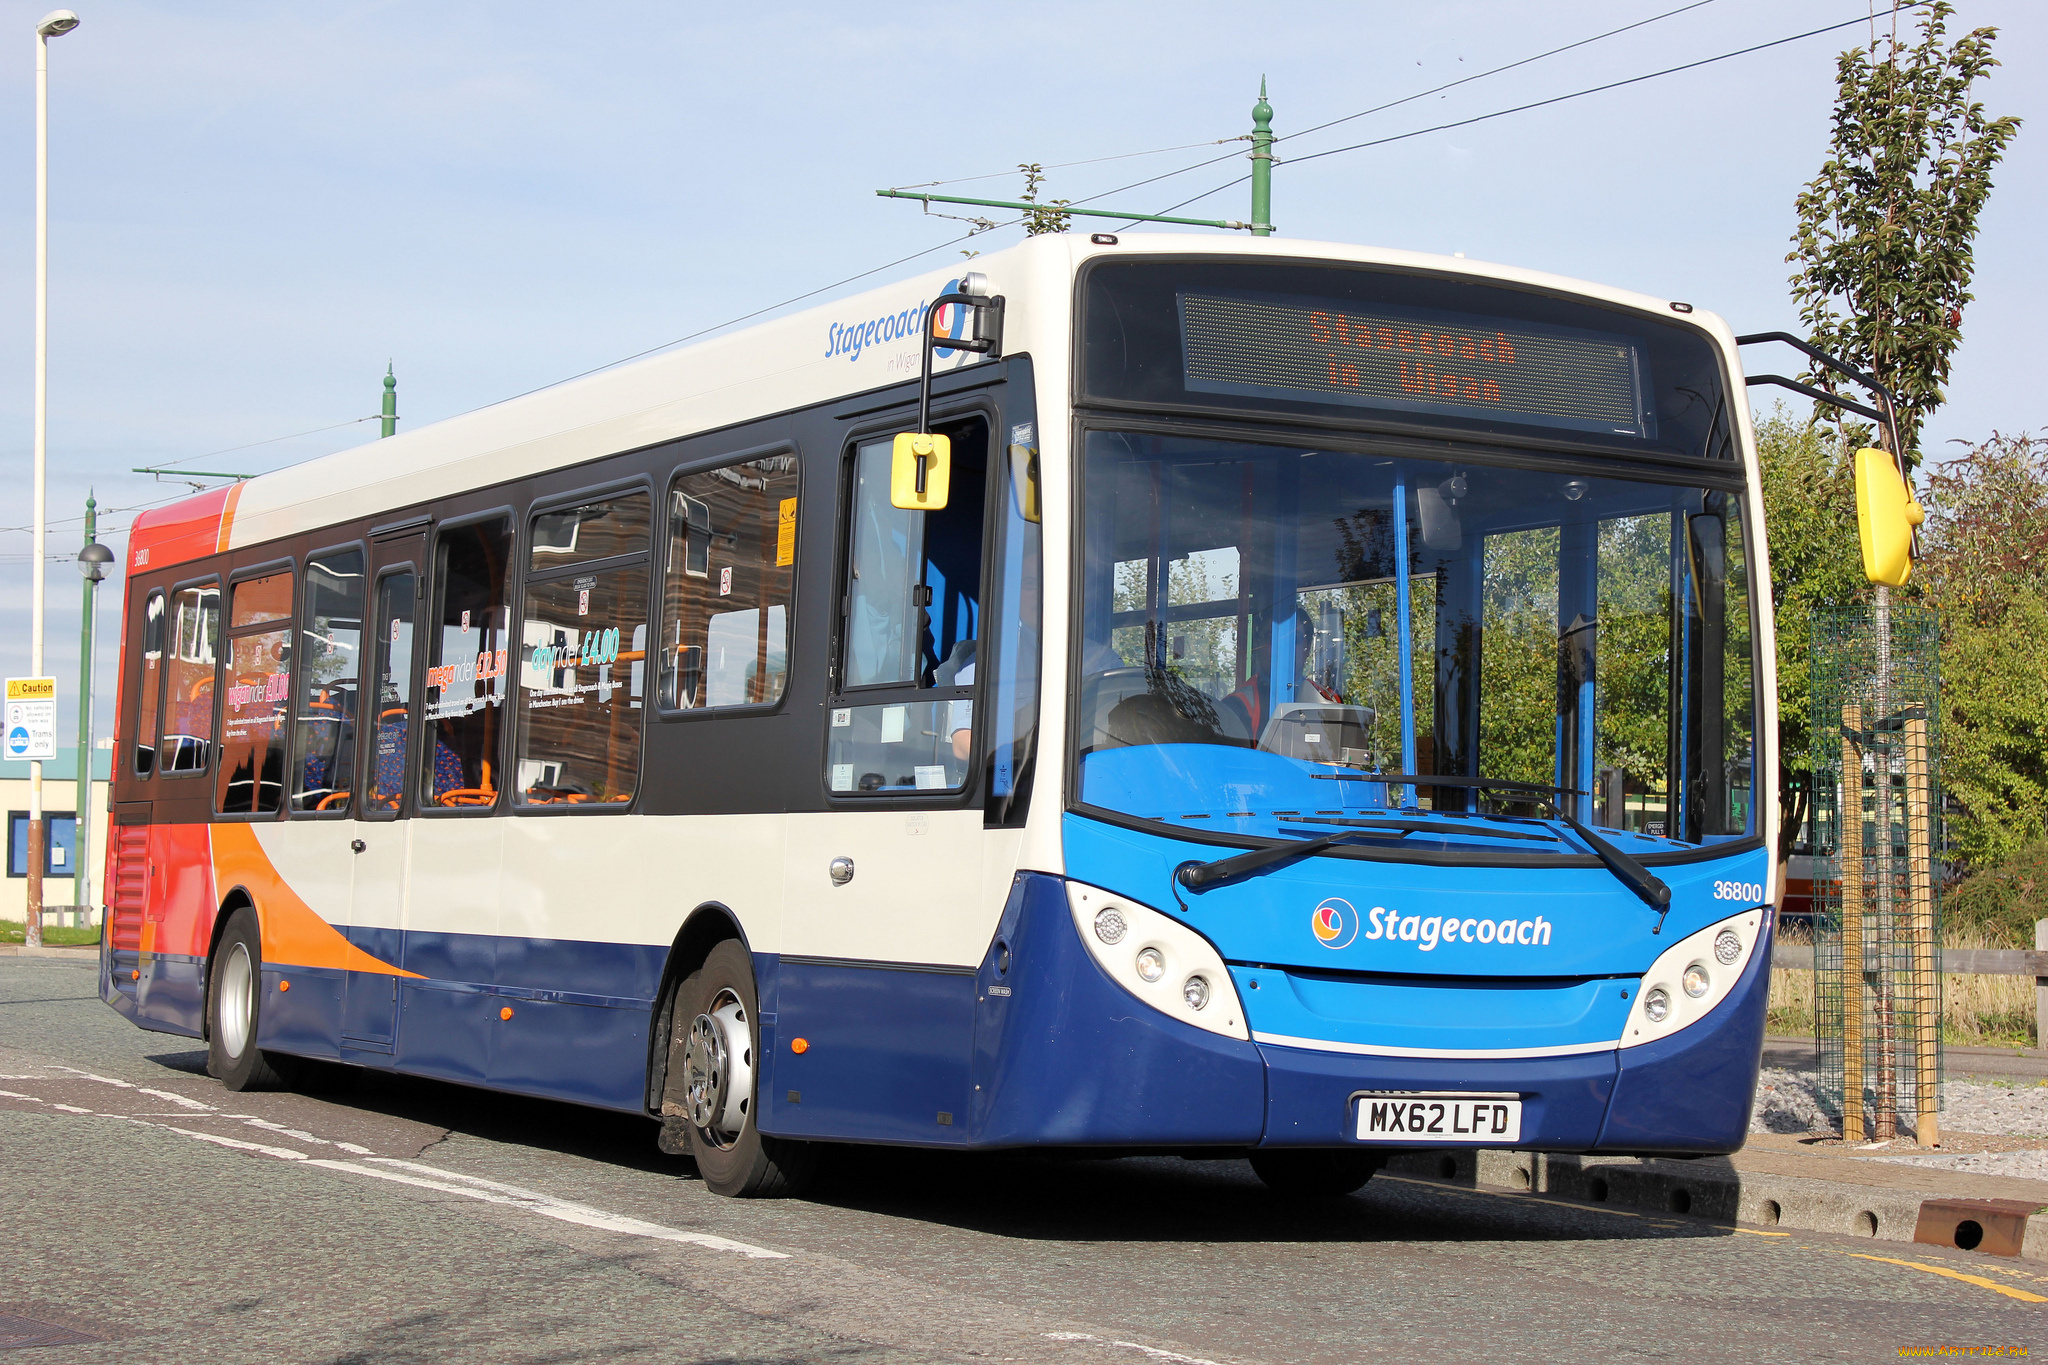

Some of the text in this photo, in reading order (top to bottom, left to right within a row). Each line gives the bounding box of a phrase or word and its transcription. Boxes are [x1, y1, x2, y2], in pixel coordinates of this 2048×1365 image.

[825, 299, 928, 362] Stagecoach
[1309, 311, 1516, 363] Stagecoach
[896, 351, 920, 373] Wigan
[1327, 353, 1501, 402] in Wigan
[134, 548, 150, 567] 36800
[581, 627, 620, 667] £4.00
[475, 648, 507, 680] £12.50
[22, 683, 53, 692] Caution
[32, 730, 53, 738] Trams
[35, 740, 50, 750] only
[1713, 880, 1762, 903] 36800
[1365, 906, 1552, 951] Stagecoach
[1370, 1103, 1508, 1133] MX62 LFD
